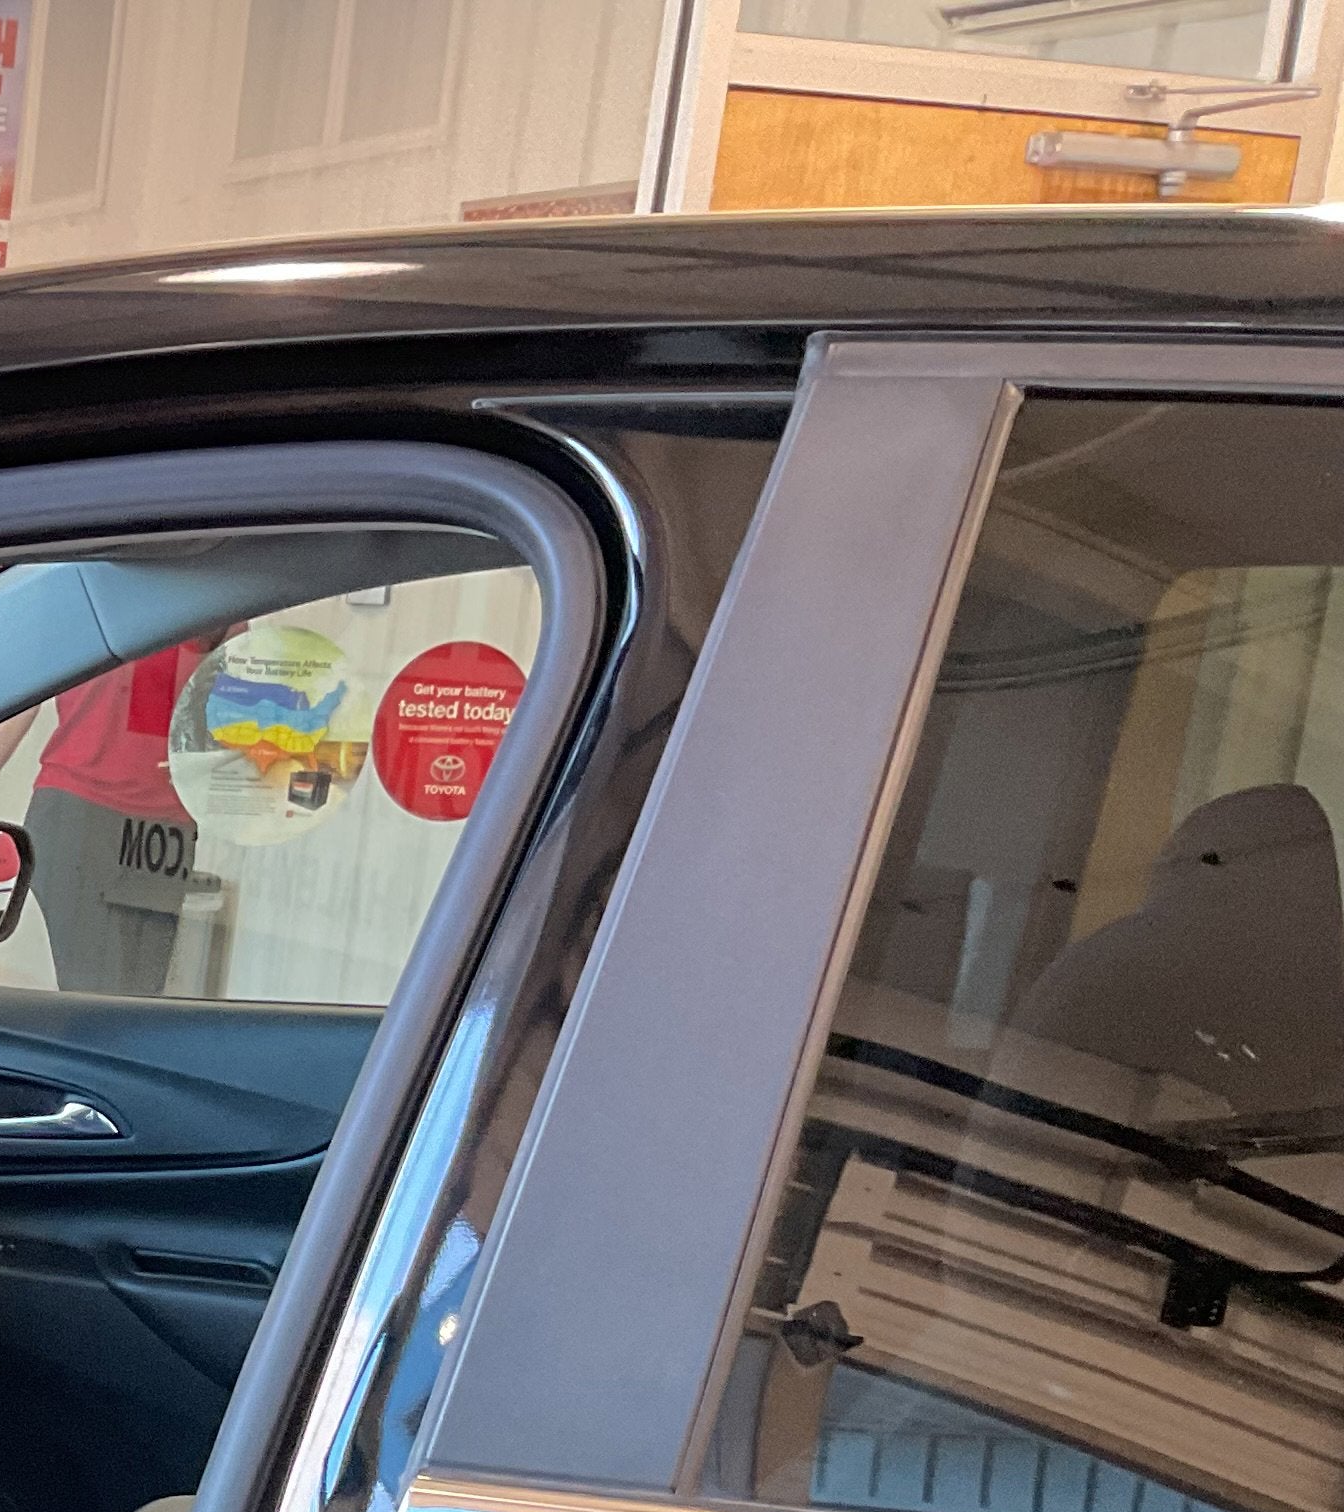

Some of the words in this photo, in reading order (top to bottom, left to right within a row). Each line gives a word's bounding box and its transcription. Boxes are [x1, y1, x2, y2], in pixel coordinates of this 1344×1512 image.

[413, 683, 435, 696] Get
[436, 685, 463, 698] your
[464, 685, 507, 700] battery
[398, 699, 460, 719] tested
[463, 702, 515, 725] today
[424, 784, 466, 796] TOYOTA
